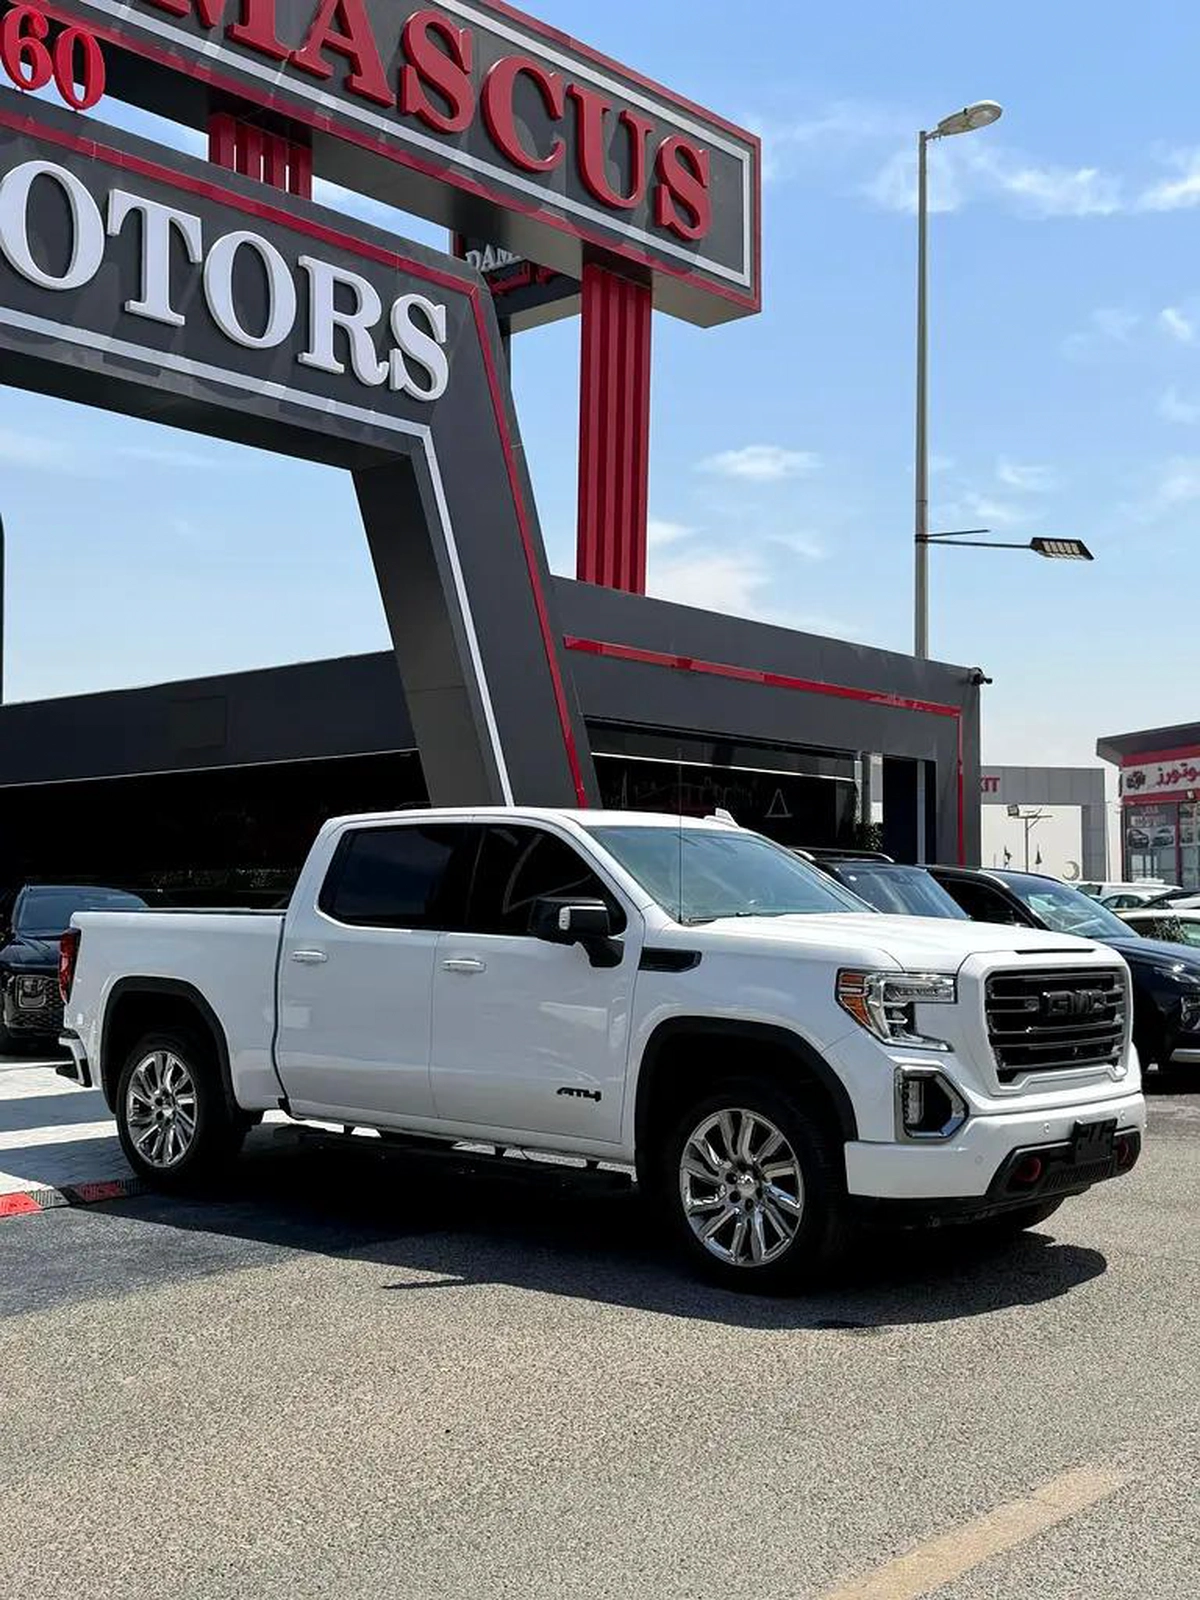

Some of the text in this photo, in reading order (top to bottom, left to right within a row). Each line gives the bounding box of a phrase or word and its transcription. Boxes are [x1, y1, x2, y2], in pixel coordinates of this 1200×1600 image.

[0, 4, 105, 110] 60
[0, 159, 450, 402] OTORS
[1154, 761, 1200, 787] وتورز
[1041, 987, 1109, 1018] GMC
[556, 1086, 602, 1103] AT4
